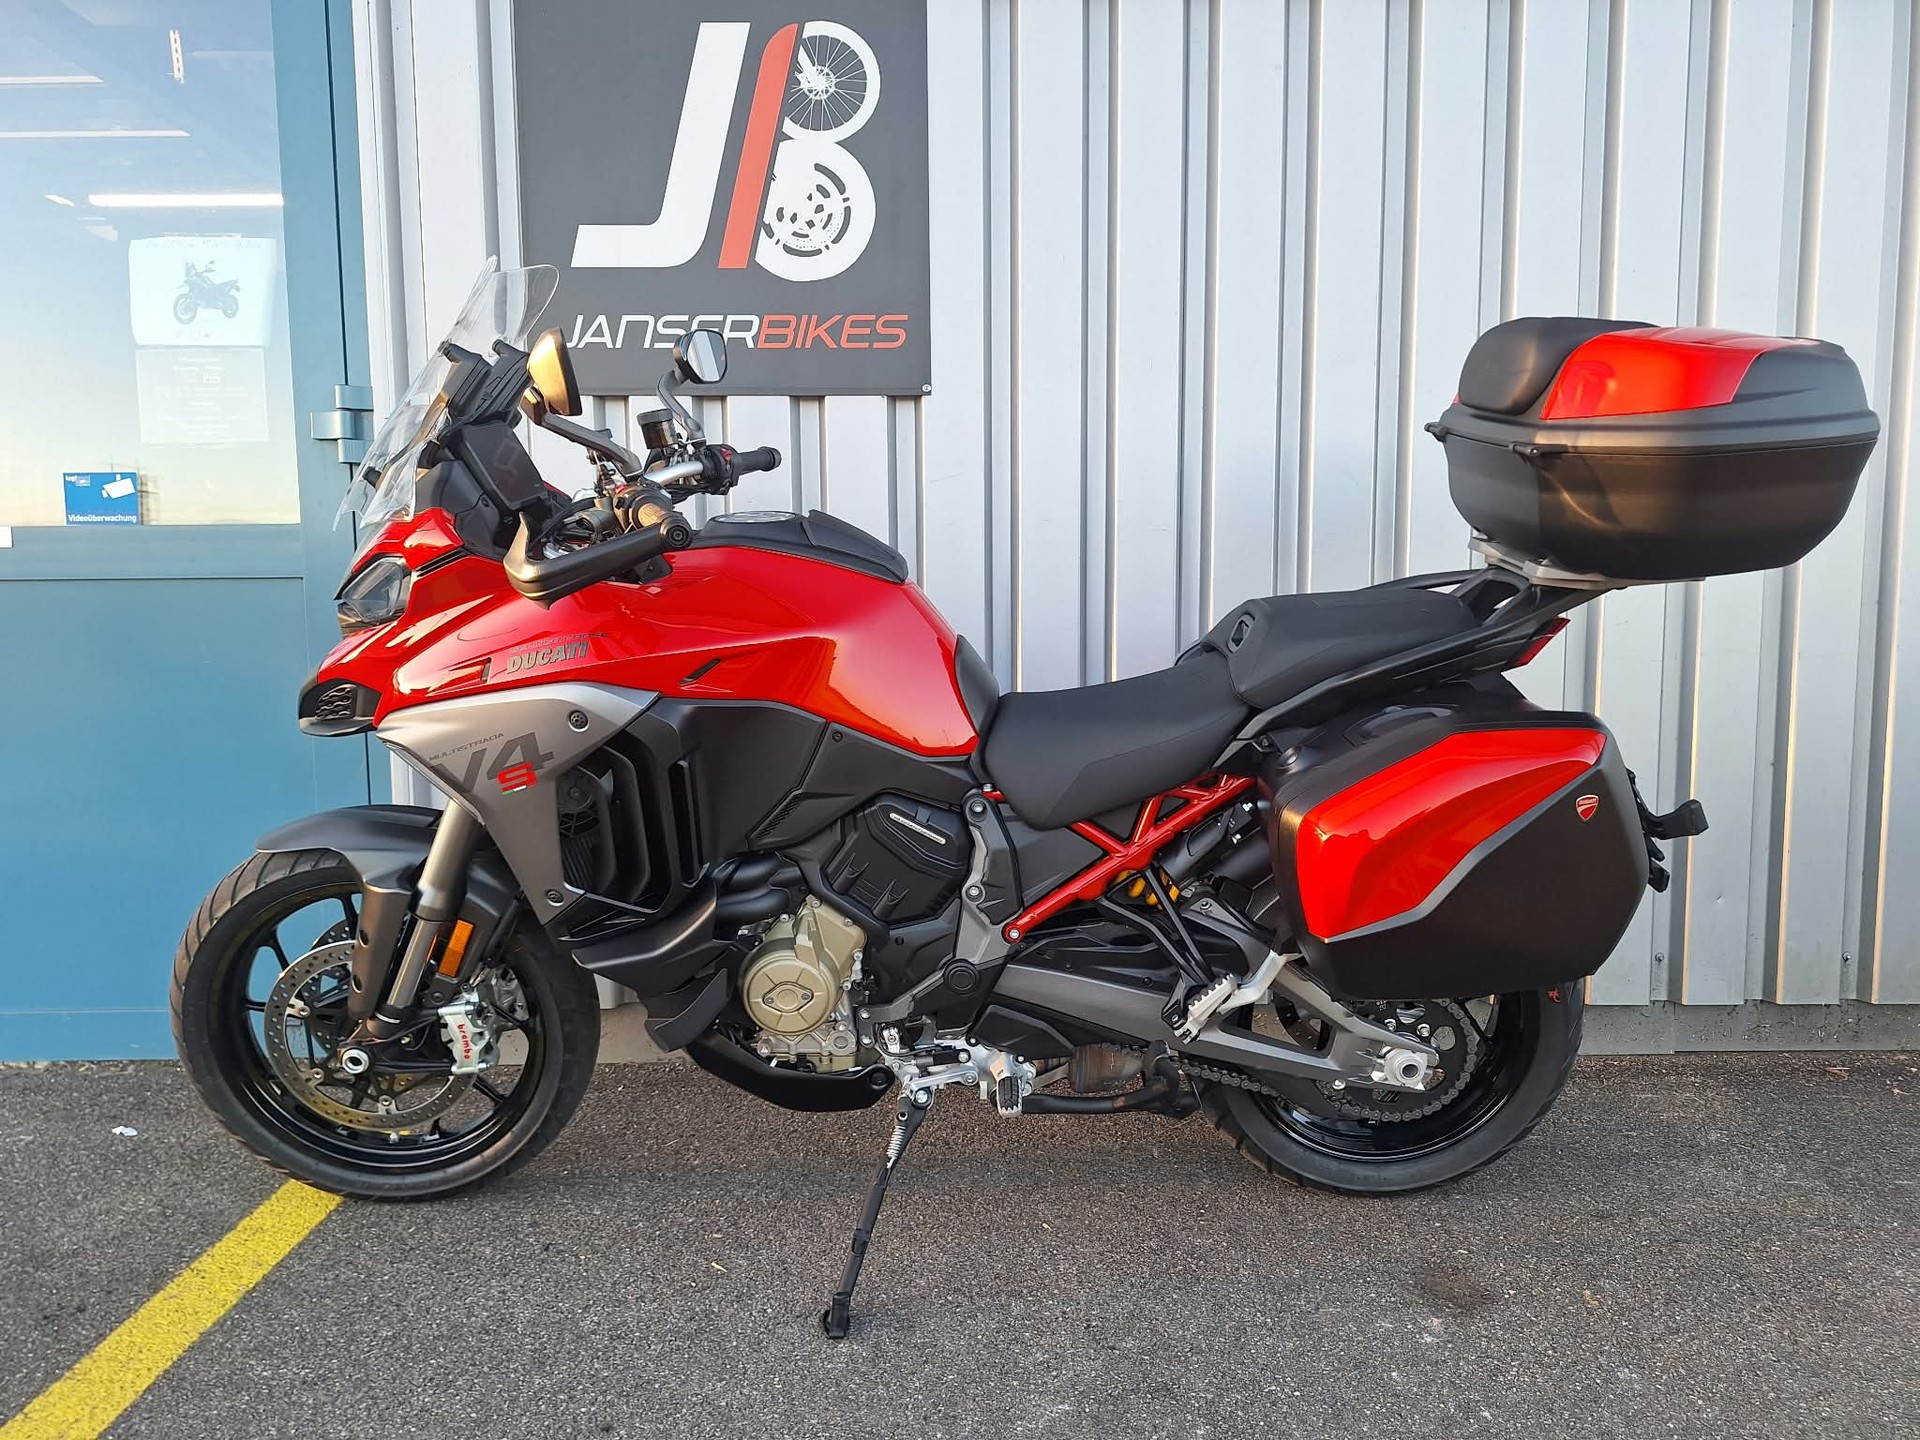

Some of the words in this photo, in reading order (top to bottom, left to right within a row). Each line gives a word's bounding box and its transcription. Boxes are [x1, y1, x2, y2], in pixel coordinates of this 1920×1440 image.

[67, 513, 137, 524] Videoüberwachung
[506, 641, 590, 674] DUCATI
[428, 731, 505, 761] MULTISTRADA
[457, 1023, 473, 1060] brembo
